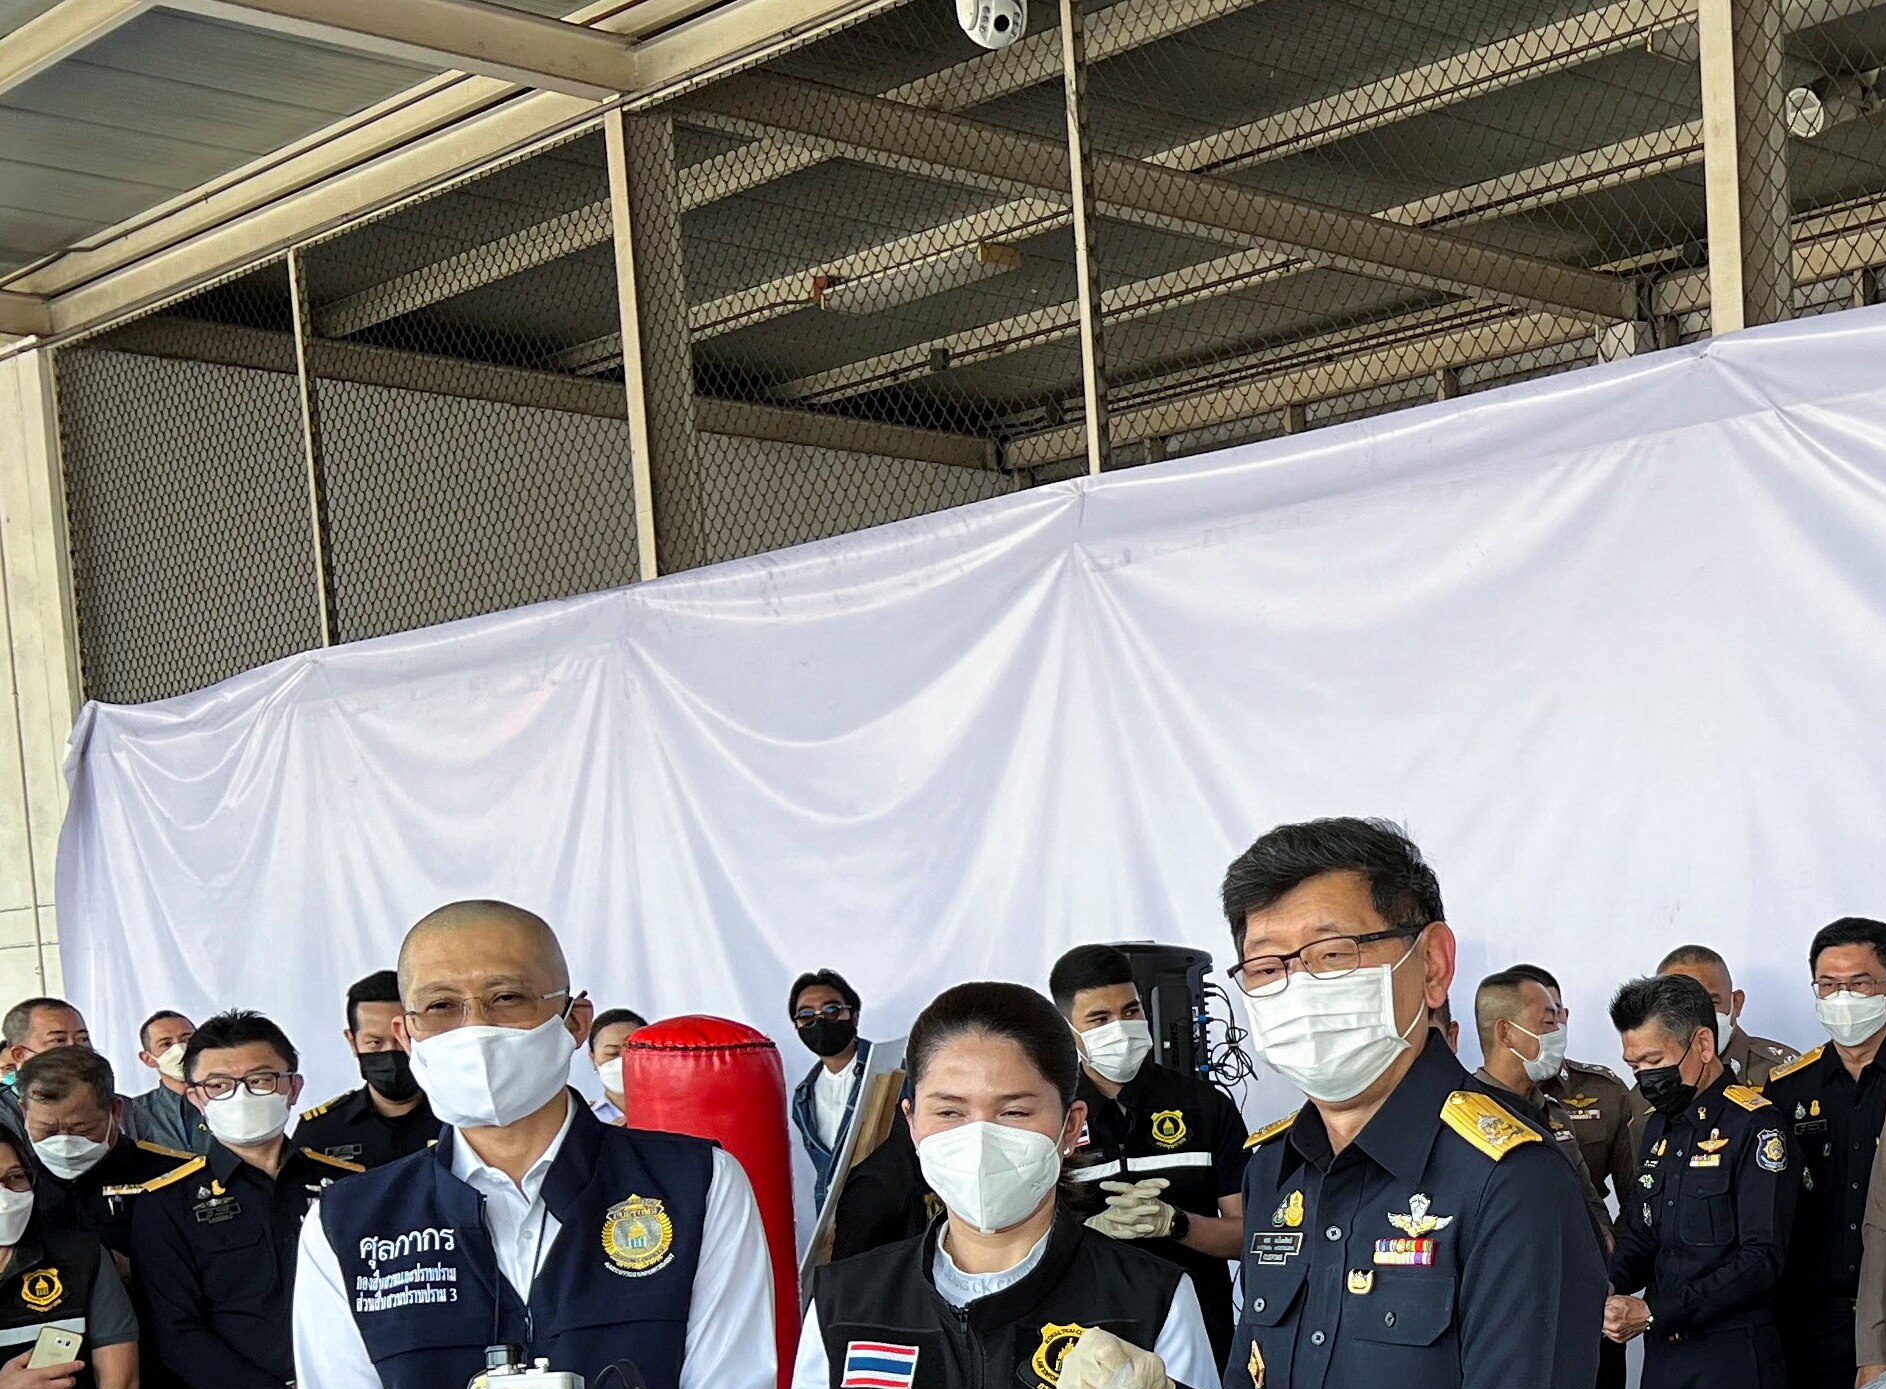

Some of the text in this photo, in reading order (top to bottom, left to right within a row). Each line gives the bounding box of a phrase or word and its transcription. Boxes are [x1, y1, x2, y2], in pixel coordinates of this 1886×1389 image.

[360, 1227, 455, 1270] ศุลกากร
[449, 1288, 458, 1302] 3
